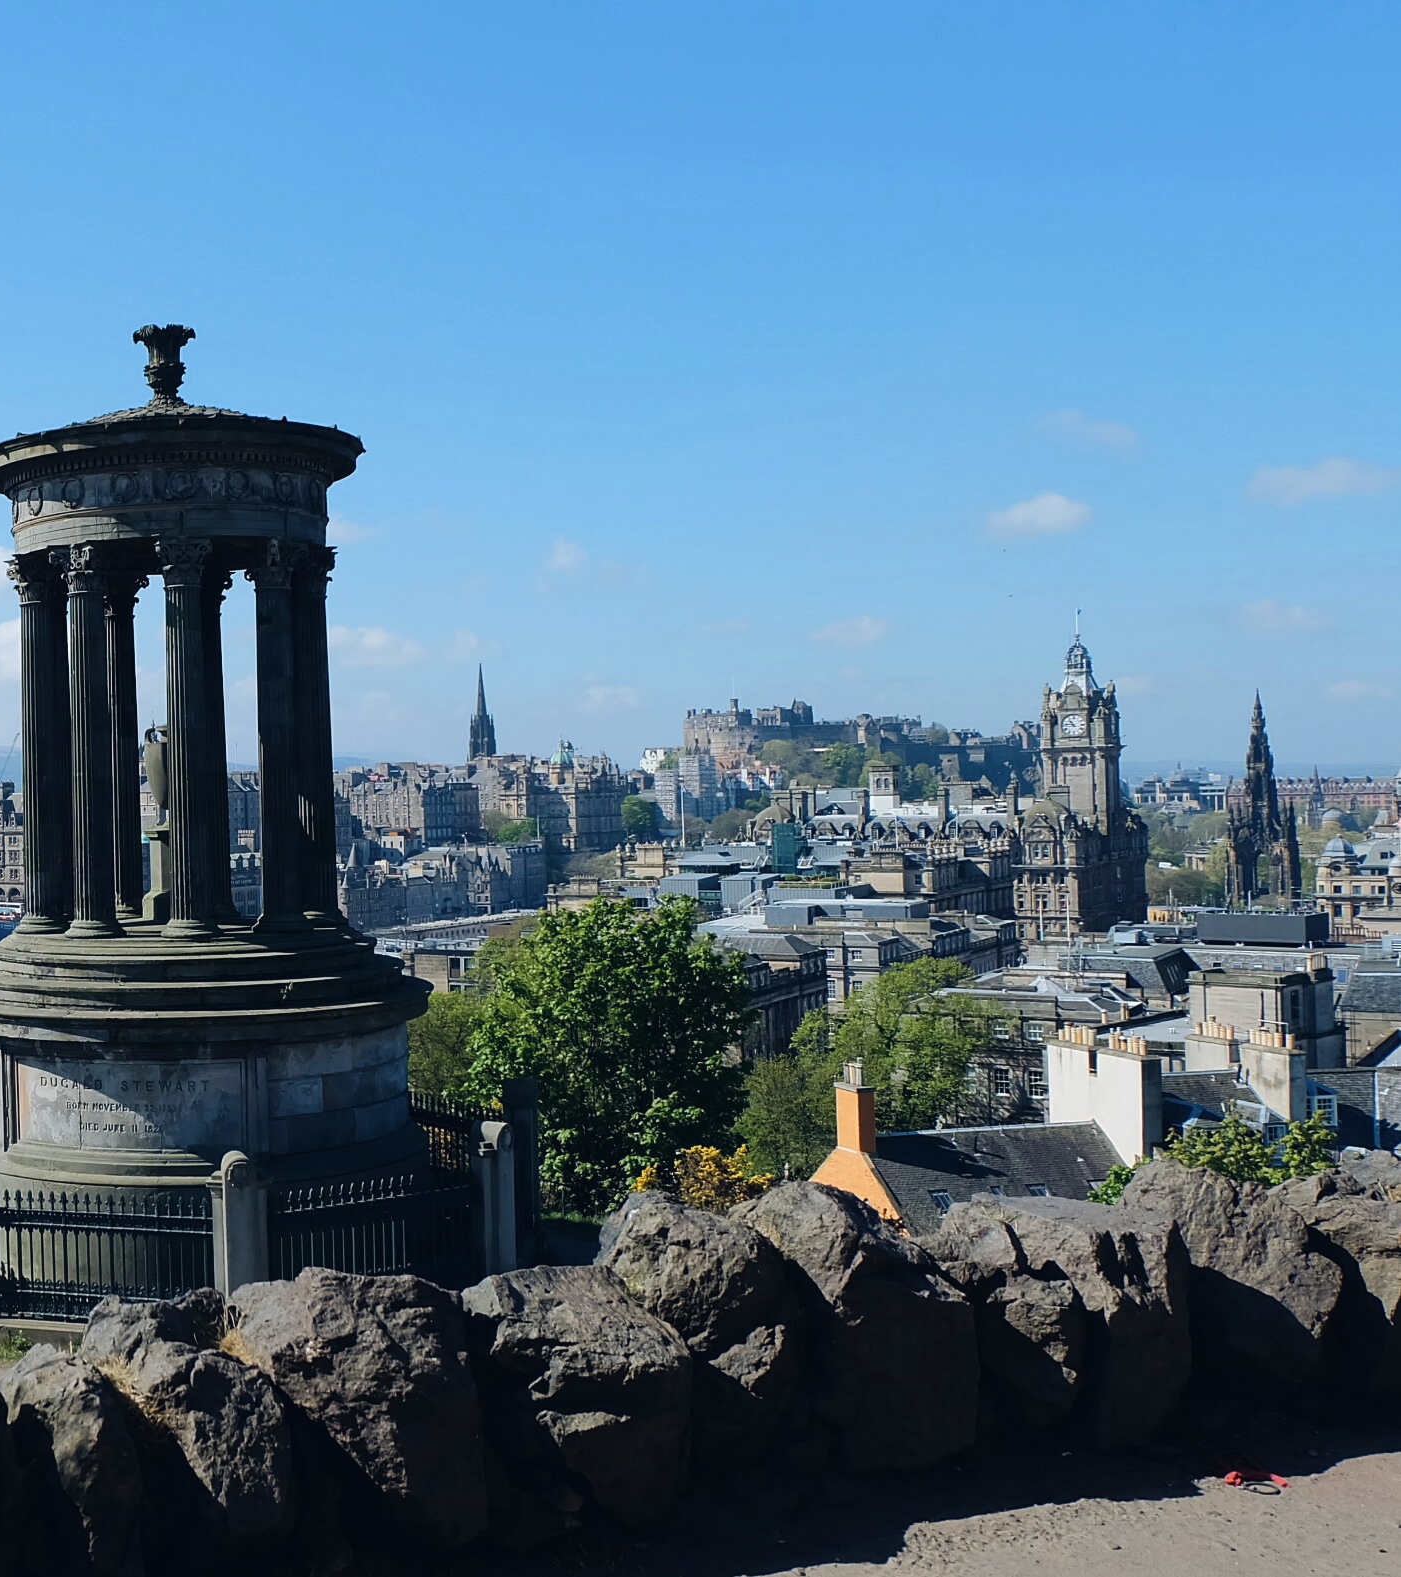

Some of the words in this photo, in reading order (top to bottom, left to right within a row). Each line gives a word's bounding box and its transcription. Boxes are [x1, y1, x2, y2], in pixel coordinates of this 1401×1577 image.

[40, 1076, 103, 1091] DUGALD
[120, 1080, 210, 1092] STEWART
[66, 1101, 89, 1111] BORN
[92, 1101, 140, 1113] NOVEMBER
[144, 1104, 155, 1113] 22
[79, 1122, 99, 1131] DIED
